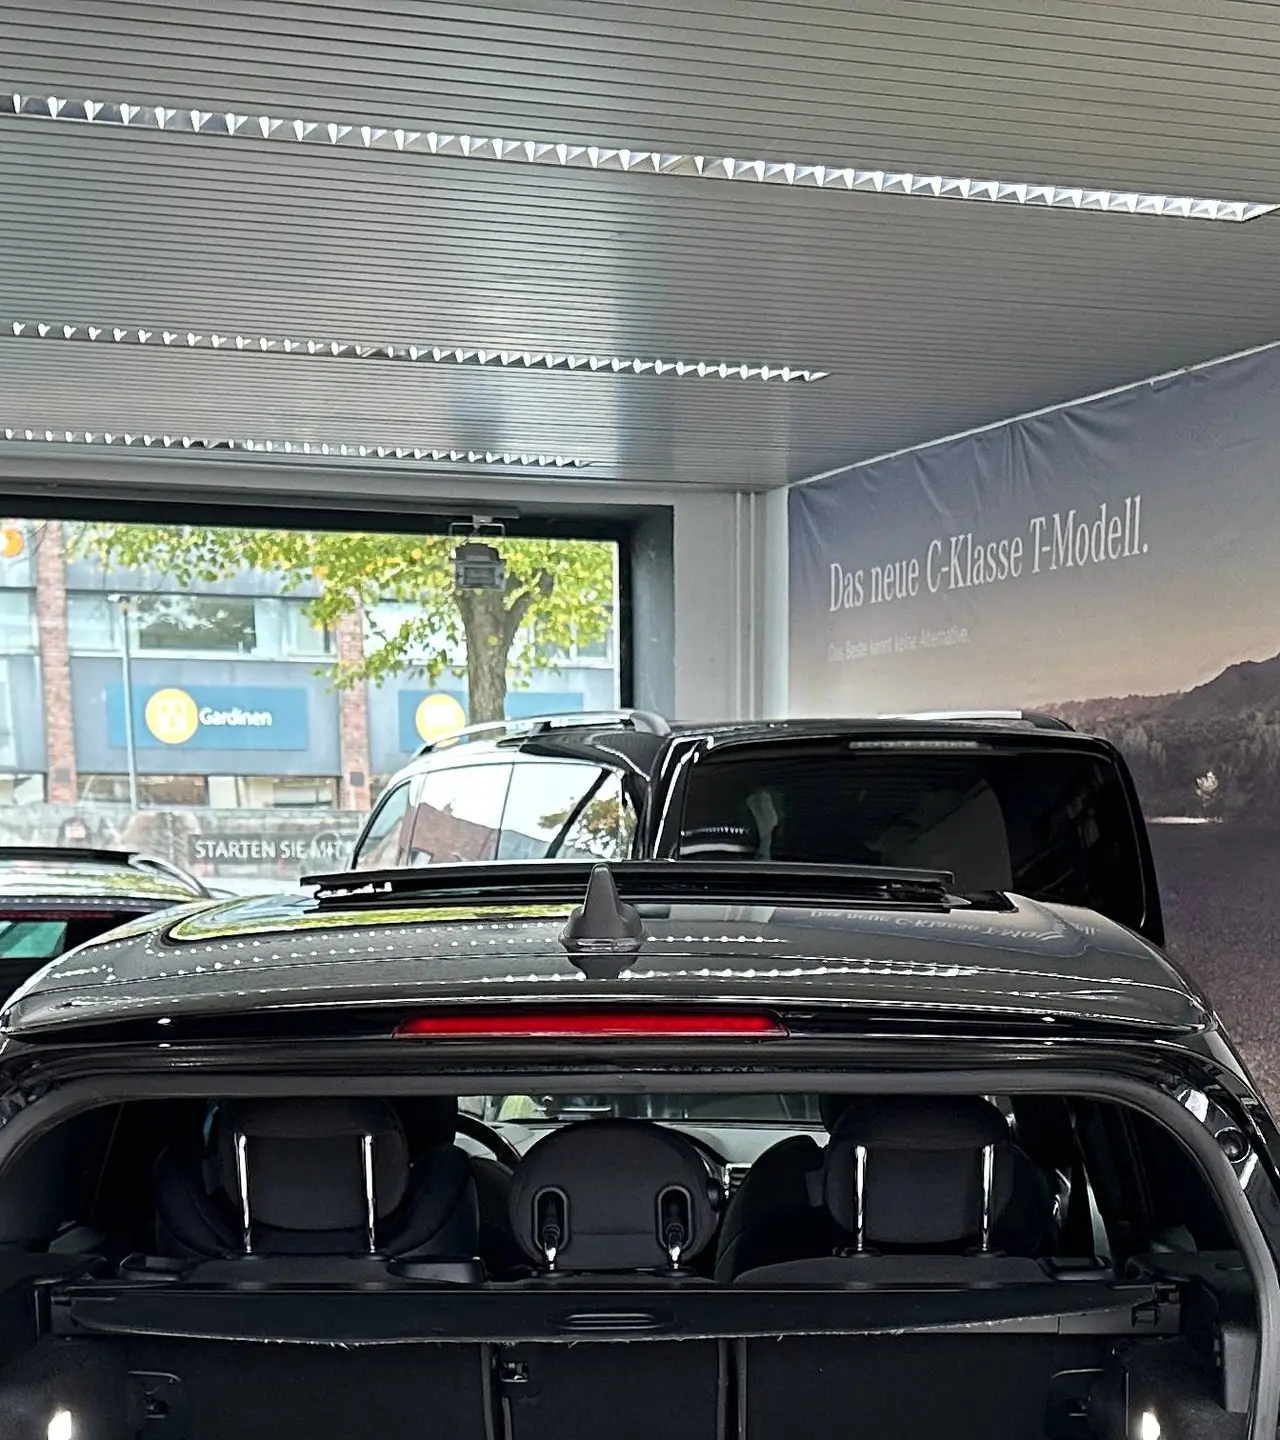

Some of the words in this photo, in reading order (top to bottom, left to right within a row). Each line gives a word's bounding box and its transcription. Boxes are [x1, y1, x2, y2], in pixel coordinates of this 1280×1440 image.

[828, 562, 864, 612] Das
[870, 557, 919, 604] neue
[926, 532, 1023, 594] C-Klasse
[1028, 494, 1149, 575] T-Modell.
[199, 706, 273, 727] Gardinen
[194, 839, 276, 859] STARTEN
[280, 839, 307, 859] SIE
